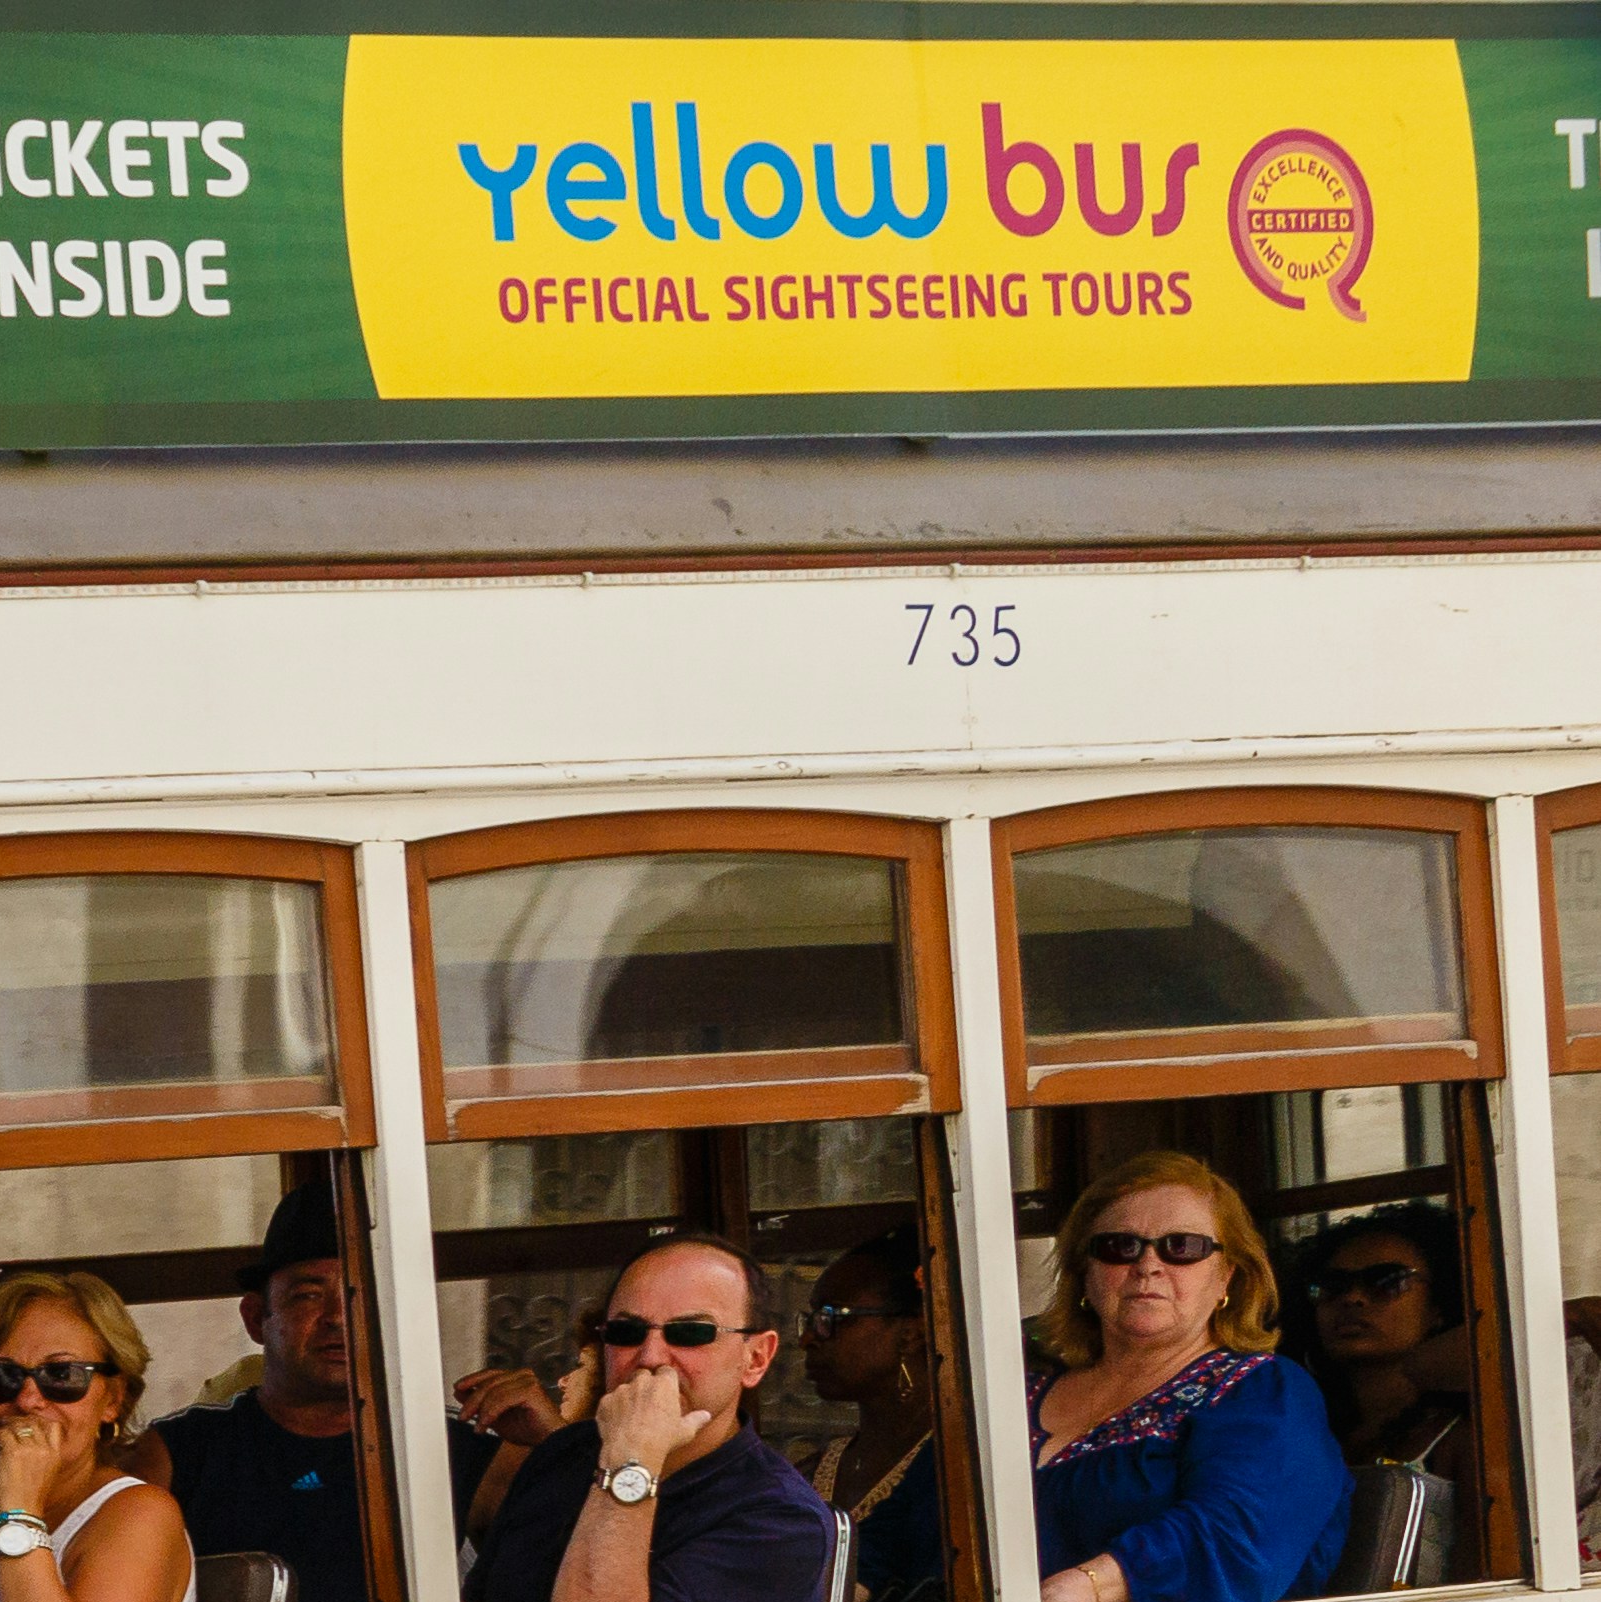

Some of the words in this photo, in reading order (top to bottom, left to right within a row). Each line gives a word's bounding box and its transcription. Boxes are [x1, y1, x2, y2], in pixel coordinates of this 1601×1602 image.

[458, 102, 948, 242] yellow
[981, 102, 1200, 238] bus
[1253, 157, 1346, 204] EXCELLENCE
[1554, 118, 1601, 190] T
[1251, 212, 1350, 230] CERTIFIED
[1256, 236, 1284, 270] AND
[1287, 235, 1348, 281] QUALITY
[498, 276, 710, 324] OFFICIAL
[724, 273, 1028, 322] SIGHTSEEING
[1042, 271, 1193, 317] TOURS
[904, 603, 1021, 667] 735
